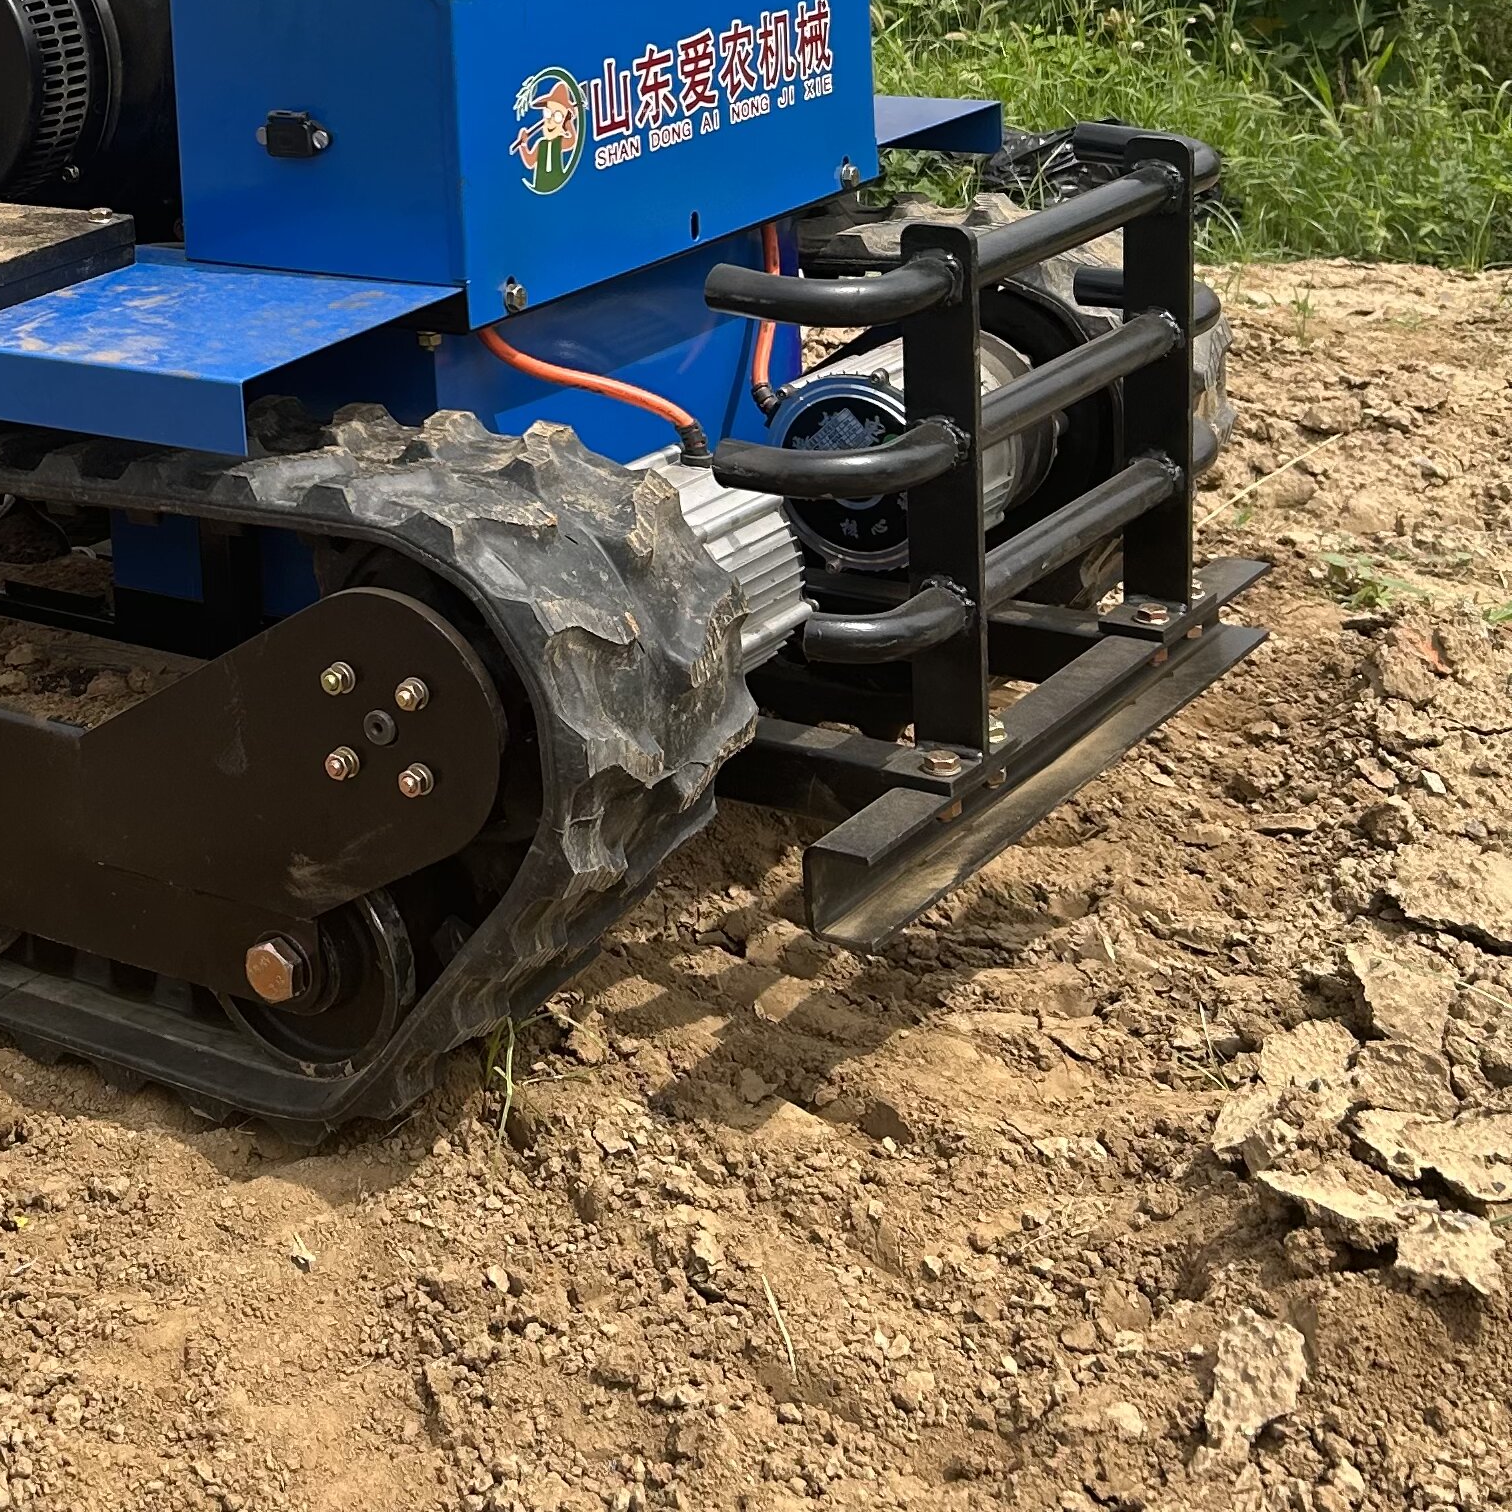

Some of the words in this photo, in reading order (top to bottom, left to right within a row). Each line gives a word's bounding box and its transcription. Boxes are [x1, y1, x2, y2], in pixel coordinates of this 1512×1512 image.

[595, 136, 641, 170] SHAN
[650, 119, 692, 151] DONG
[701, 109, 719, 135] AI
[730, 94, 770, 125] NONG
[778, 85, 795, 108] JI
[804, 74, 833, 100] XIE
